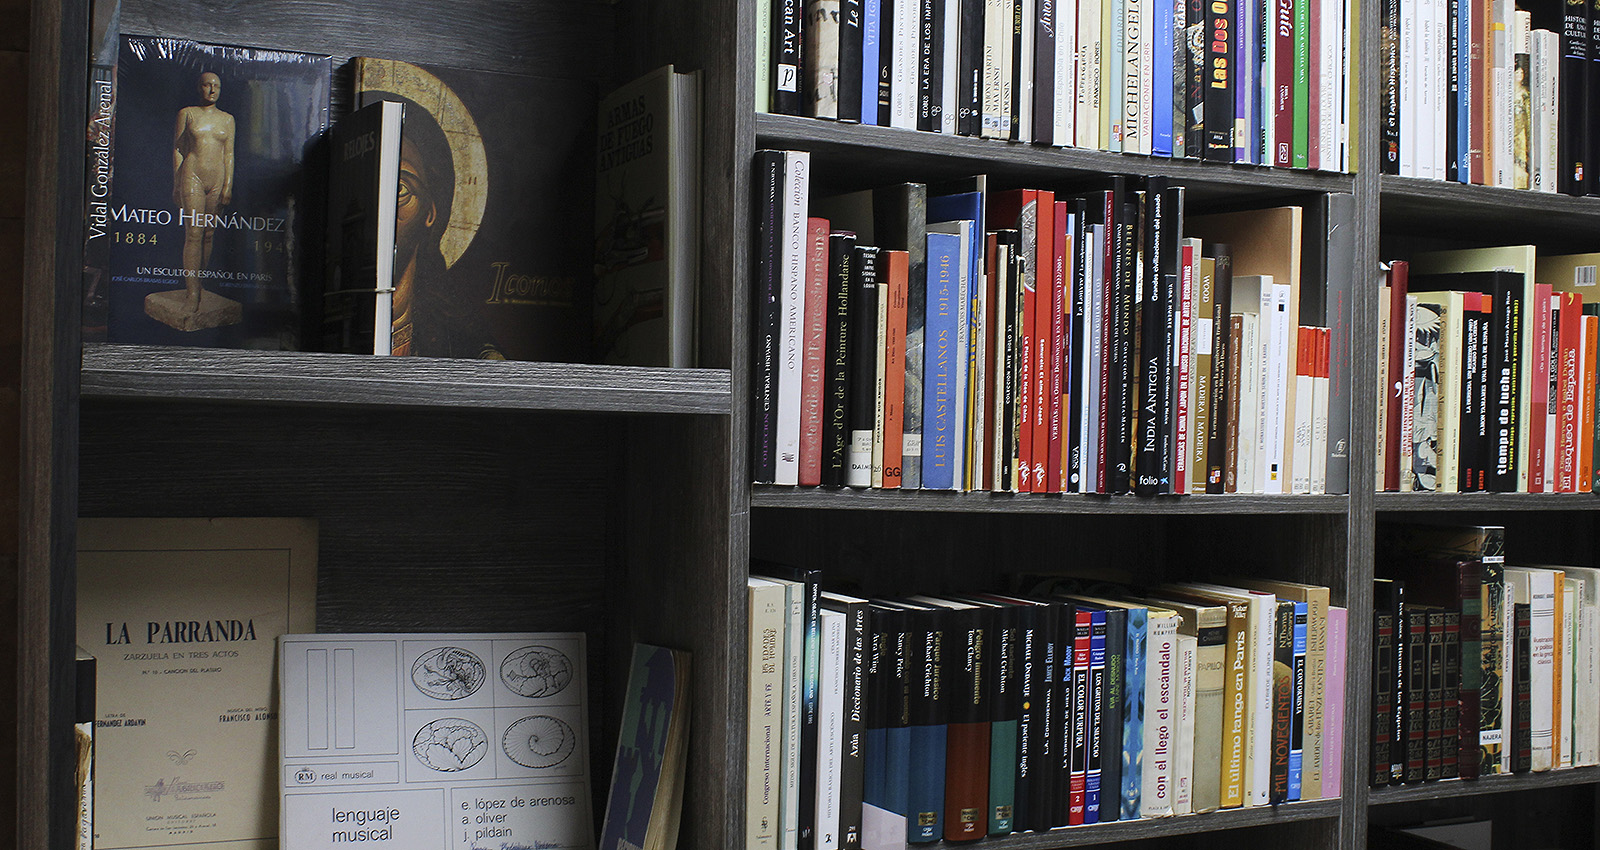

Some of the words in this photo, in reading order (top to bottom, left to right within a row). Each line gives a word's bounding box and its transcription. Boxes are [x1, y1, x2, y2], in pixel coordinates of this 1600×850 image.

[847, 10, 859, 28] Le
[867, 17, 876, 46] VITA
[1013, 4, 1021, 34] MURILLO
[783, 28, 796, 54] Art
[1212, 18, 1228, 53] Dos
[985, 45, 993, 76] MARTINI
[1143, 65, 1150, 76] EN
[1212, 58, 1227, 88] Las
[95, 79, 112, 128] Arenal
[984, 78, 992, 111] SIMONE
[1002, 82, 1010, 114] POUSSIN
[1143, 78, 1151, 136] VARIACIONES
[606, 95, 646, 127] ARMAS
[343, 130, 375, 163] RELOJES
[600, 131, 615, 153] DE
[616, 114, 654, 146] FUEGO
[91, 131, 111, 198] González
[599, 136, 653, 172] ANTIGUAS
[793, 160, 804, 206] Colección
[88, 200, 107, 240] Vidal
[110, 203, 172, 227] MATEO
[178, 208, 286, 233] HERNÁNDEZ
[1153, 194, 1163, 218] pasado
[114, 231, 158, 246] 1884
[791, 212, 800, 250] BANCO
[1153, 219, 1162, 229] del
[1151, 230, 1161, 273] civilizaciones
[136, 266, 153, 275] UN
[153, 267, 195, 278] ESCULTOR
[197, 268, 235, 281] ESPAÑOL
[237, 272, 248, 281] EN
[250, 271, 273, 282] PARÍS
[790, 254, 800, 300] HISPANO
[838, 255, 850, 316] Hollandaise
[938, 255, 951, 318] 1915-1946
[1151, 274, 1160, 302] Grandes
[1202, 275, 1210, 303] WOOD
[787, 302, 798, 371] AMERICANO
[836, 321, 849, 367] Peinture
[1214, 337, 1222, 372] arquitectura
[835, 370, 846, 381] la
[936, 330, 948, 432] CASTELLANOS
[1145, 357, 1159, 414] ANTIGUA
[1498, 368, 1510, 404] lucha
[1565, 348, 1576, 402] España
[834, 385, 846, 400] de
[1197, 375, 1207, 413] MADERA
[833, 403, 845, 431] d'Or
[1498, 409, 1509, 425] de
[1565, 405, 1574, 421] de
[1143, 417, 1156, 453] INDIA
[1195, 421, 1205, 462] MADEIRA
[1564, 423, 1575, 473] saqueo
[935, 435, 946, 468] LUIS
[1496, 429, 1510, 476] tiempo
[885, 466, 901, 477] GG
[1139, 475, 1158, 486] folio
[1562, 475, 1571, 490] El
[105, 621, 131, 645] LA
[147, 619, 258, 644] PARRANDA
[855, 609, 864, 635] Artes
[123, 652, 169, 661] ZARZUELA
[172, 652, 185, 660] EN
[189, 651, 210, 660] TRES
[212, 650, 239, 659] ACTOS
[853, 652, 862, 665] de
[854, 637, 863, 651] las
[933, 631, 943, 662] Parque
[974, 628, 984, 659] Peligro
[1000, 629, 1009, 659] Michael
[1233, 630, 1246, 671] París
[933, 664, 942, 700] Jurásico
[974, 661, 983, 705] inminente
[999, 659, 1008, 693] Crichton
[1078, 674, 1086, 683] EL
[1157, 642, 1171, 704] escándalo
[1234, 672, 1243, 691] en
[851, 666, 862, 722] Diccionario
[1077, 685, 1086, 711] COLOR
[1157, 709, 1169, 720] el
[1229, 692, 1244, 734] tango
[1275, 675, 1290, 766] NOVECIENTOS
[1076, 712, 1085, 748] PURPURA
[1155, 726, 1170, 755] llegó
[849, 733, 859, 758] Azúa
[1228, 736, 1242, 783] último
[298, 771, 314, 781] RM
[320, 769, 338, 780] real
[341, 768, 374, 779] musical
[1155, 760, 1167, 771] él
[1275, 768, 1288, 793] MIL
[1156, 775, 1167, 799] con
[1228, 784, 1240, 799] El
[332, 806, 401, 826] lenguaje
[461, 800, 472, 811] e.
[475, 796, 506, 812] lópez
[510, 795, 526, 808] de
[529, 795, 576, 808] arenosa
[332, 825, 393, 843] musical
[461, 814, 472, 826] a.
[475, 812, 508, 825] oliver
[475, 826, 512, 841] pildain
